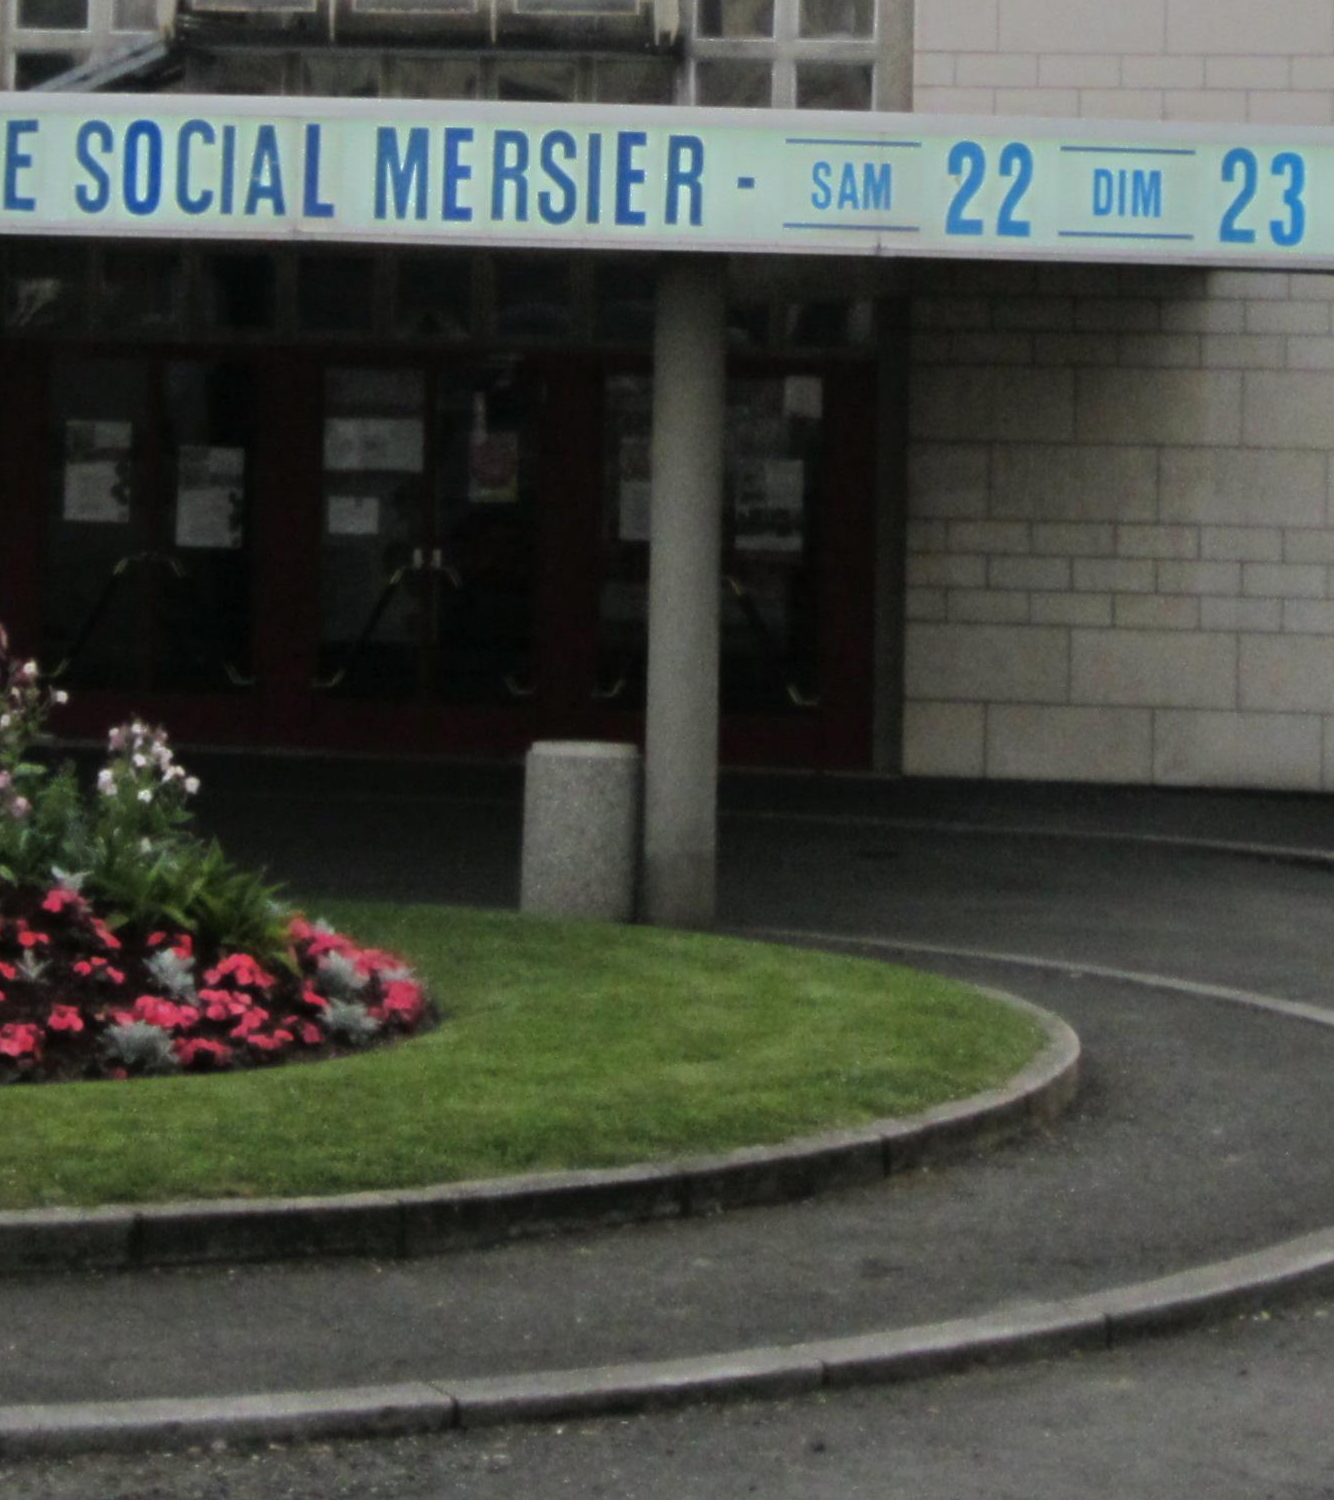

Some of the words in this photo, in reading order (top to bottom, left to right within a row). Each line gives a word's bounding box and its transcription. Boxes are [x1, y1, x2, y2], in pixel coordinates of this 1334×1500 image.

[74, 118, 336, 218] SOCIAL
[374, 125, 705, 227] MERSIER
[811, 159, 893, 211] SAM
[944, 139, 1035, 239] 22
[1091, 166, 1164, 220] DIM
[1216, 147, 1308, 248] 23
